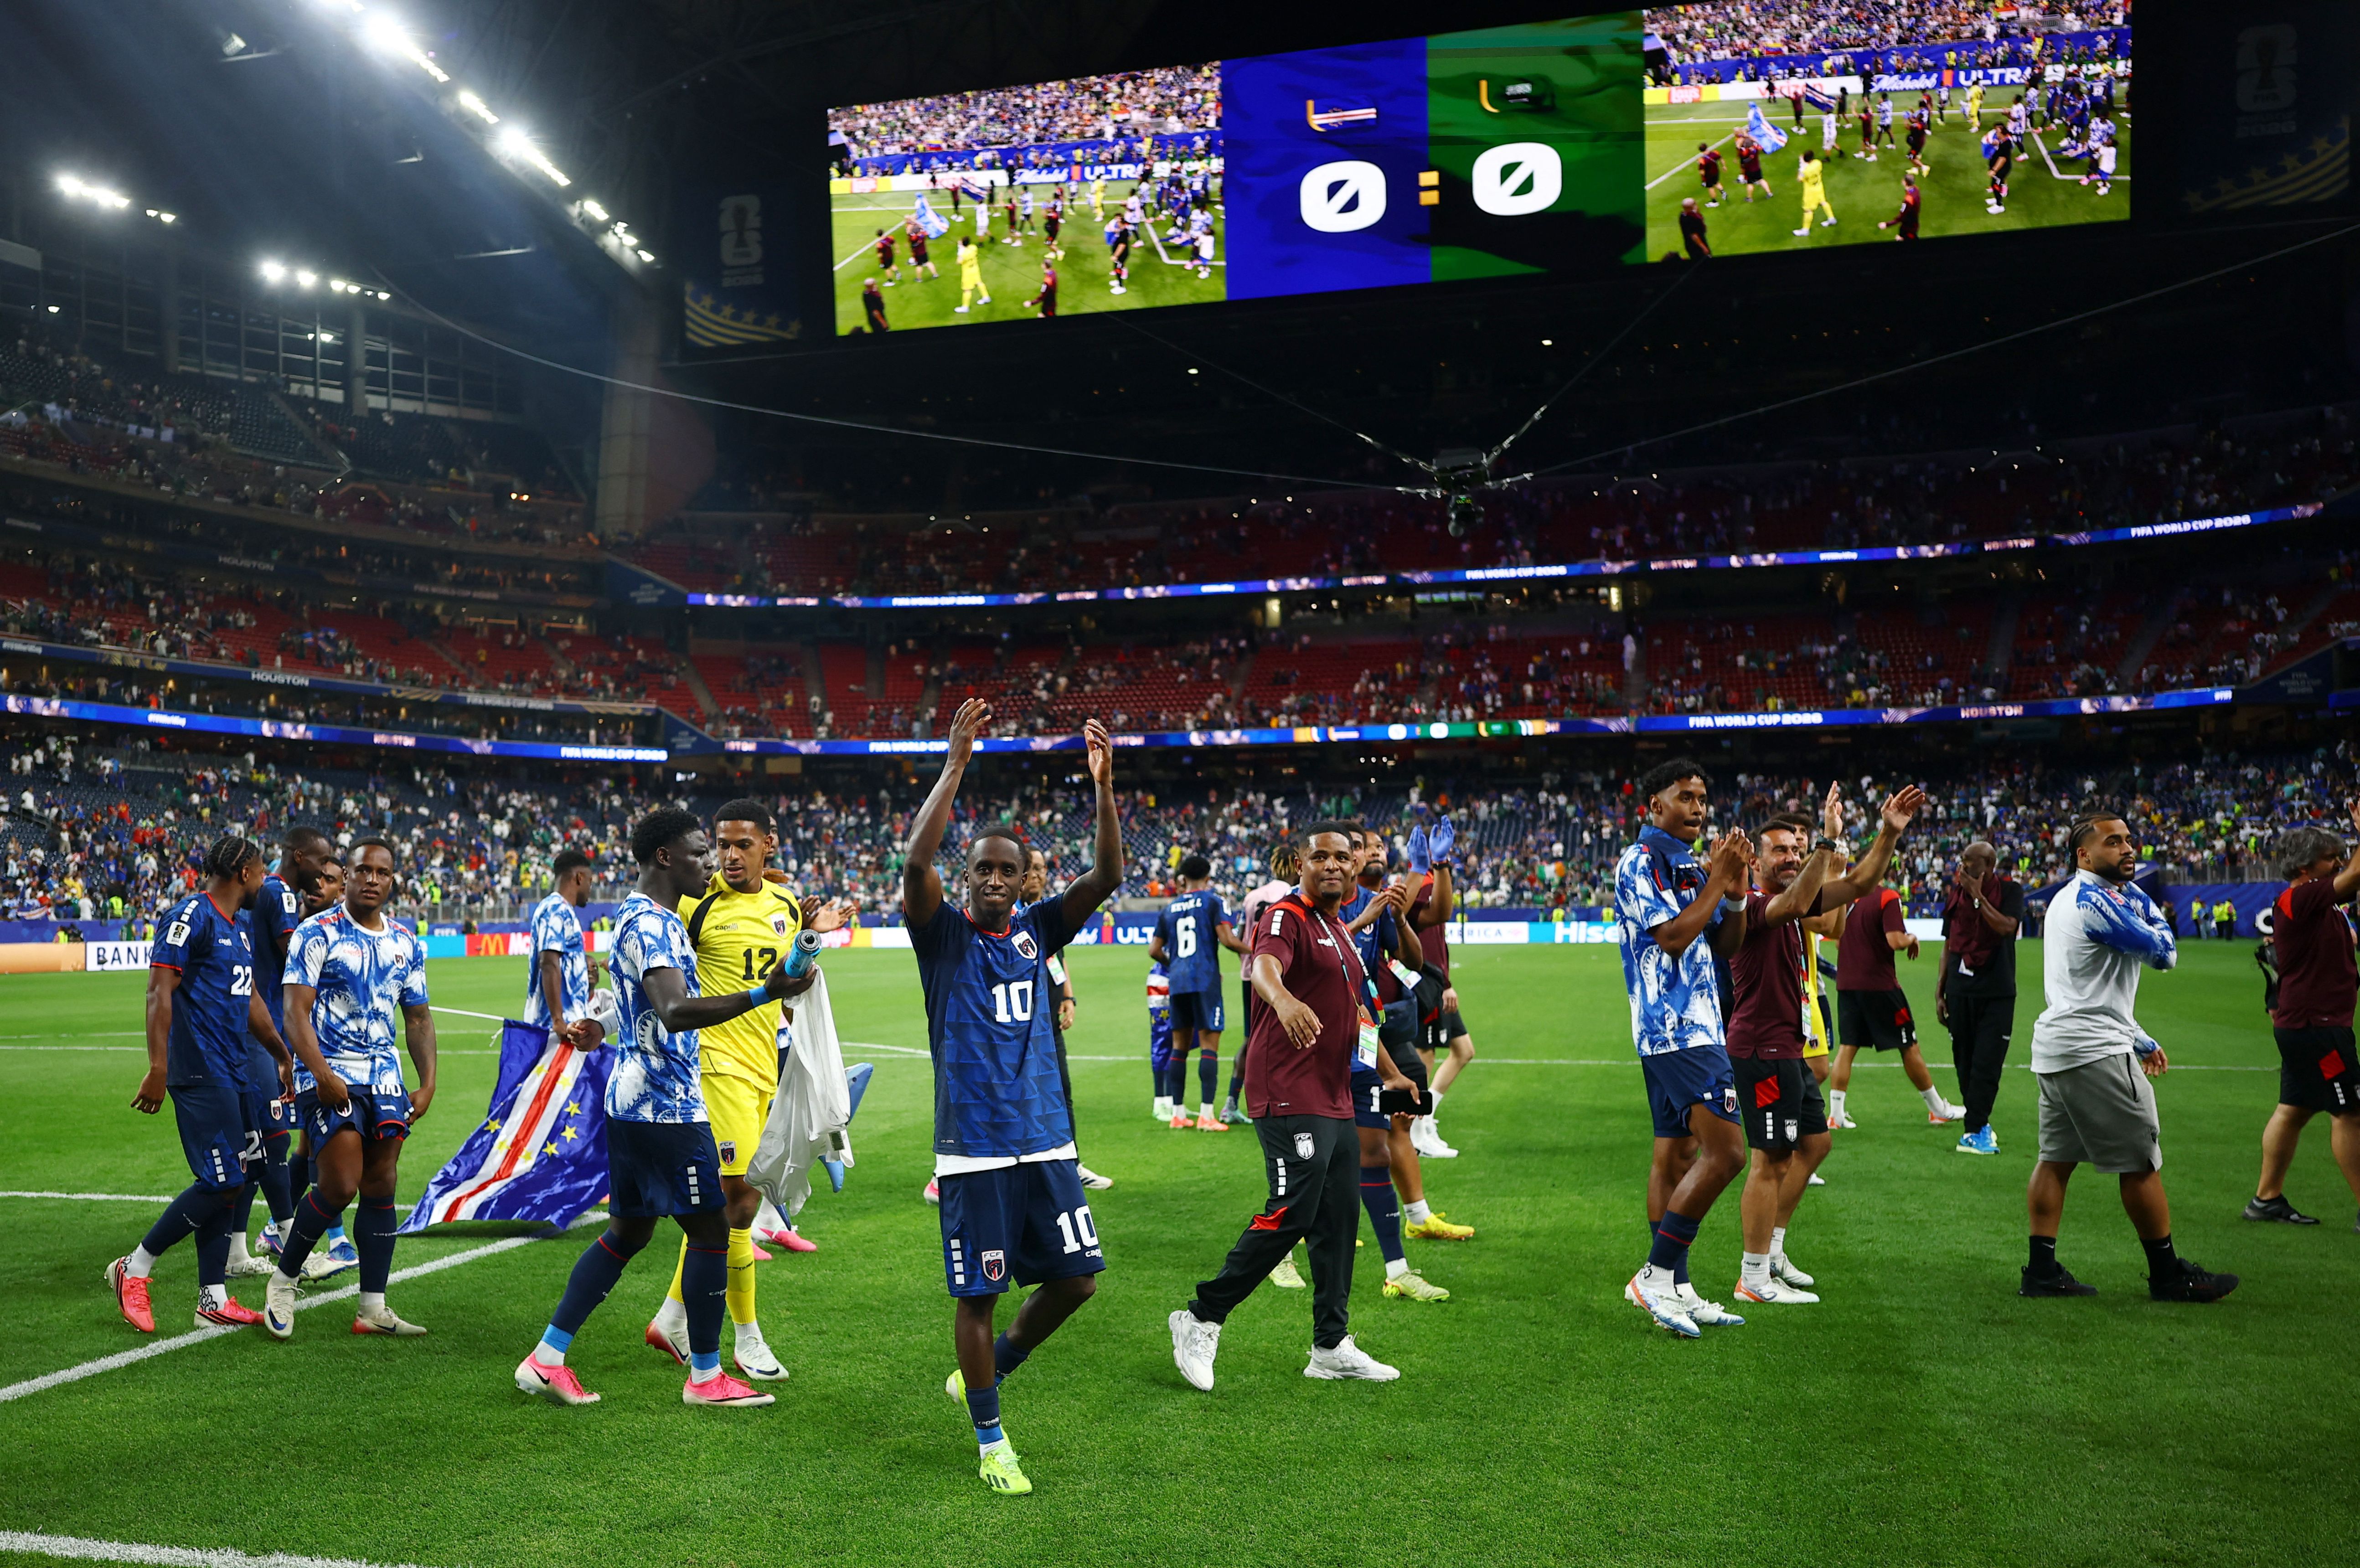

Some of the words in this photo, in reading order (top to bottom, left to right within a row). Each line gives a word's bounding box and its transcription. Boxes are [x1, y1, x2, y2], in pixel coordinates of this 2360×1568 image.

[1300, 160, 1386, 232] 0
[1472, 142, 1562, 216] 0
[2131, 526, 2153, 538] FIFA
[2152, 522, 2192, 535] WORLD
[2191, 519, 2214, 531] CUP
[2213, 514, 2252, 528] 2026
[1466, 569, 1485, 580] FIFA
[1485, 568, 1517, 579] WORLD
[1517, 567, 1535, 578] CUP
[252, 671, 309, 687] HOUSTON
[1689, 716, 1714, 728] FIFA
[1714, 714, 1757, 727] WORLD
[1756, 713, 1782, 726] CUP
[1781, 712, 1823, 725] 2026
[1961, 705, 2024, 718] HOUSTON
[560, 746, 582, 758] FIFA
[581, 747, 616, 759] WORLD
[615, 748, 635, 760] CUP
[868, 741, 891, 753] FIFA
[891, 741, 928, 752] WORLD
[928, 741, 950, 752] CUP
[434, 928, 457, 936] FIFA
[1117, 927, 1156, 944] ULT
[1177, 916, 1197, 958] 6
[1554, 921, 1620, 944] Hise
[97, 946, 152, 965] BANK
[743, 948, 777, 980] 12
[231, 965, 252, 996] 22
[992, 980, 1033, 1023] 10
[1056, 1205, 1100, 1254] 10
